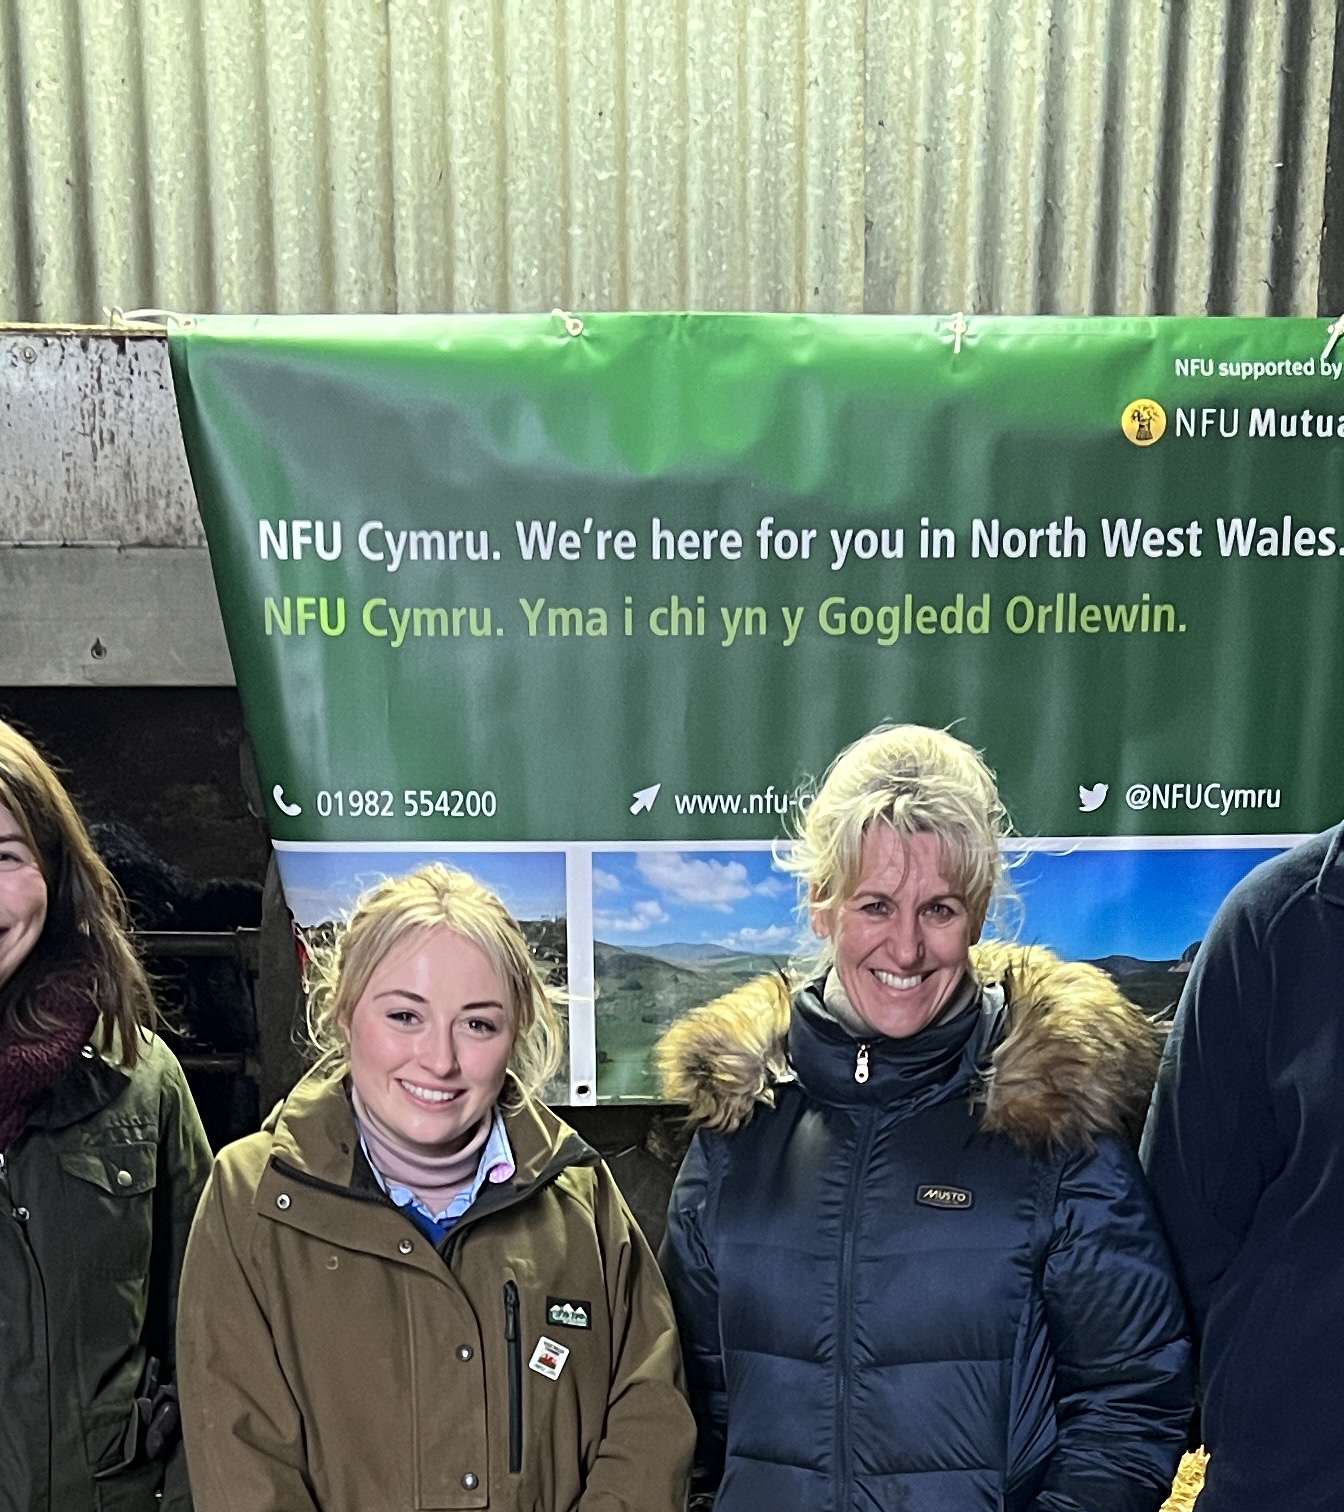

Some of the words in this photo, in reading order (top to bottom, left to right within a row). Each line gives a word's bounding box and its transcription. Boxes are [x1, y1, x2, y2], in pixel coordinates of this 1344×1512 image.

[1175, 358, 1214, 377] NFU
[1218, 356, 1315, 381] supported
[1320, 357, 1343, 380] by
[1175, 407, 1239, 438] NFU
[259, 519, 342, 561] NFU
[358, 521, 501, 572] Cymru.
[515, 517, 637, 561] We’re
[652, 517, 743, 560] here
[756, 516, 817, 560] for
[830, 528, 904, 571] you
[920, 516, 955, 559] in
[971, 515, 1086, 559] North
[1101, 516, 1203, 558] West
[264, 596, 346, 636] NFU
[362, 598, 504, 648] Cymru.
[519, 598, 608, 637] Yma
[624, 595, 634, 636] i
[649, 594, 705, 636] chi
[720, 606, 767, 647] yn
[781, 606, 805, 647] y
[818, 592, 992, 646] Gogledd
[1006, 592, 1187, 634] Orllewin.
[316, 790, 394, 817] 01982
[404, 789, 497, 817] 554200
[674, 785, 815, 816] www.nfu-c
[1125, 782, 1281, 816] @NFUCymru
[924, 1189, 966, 1202] MUSTO
